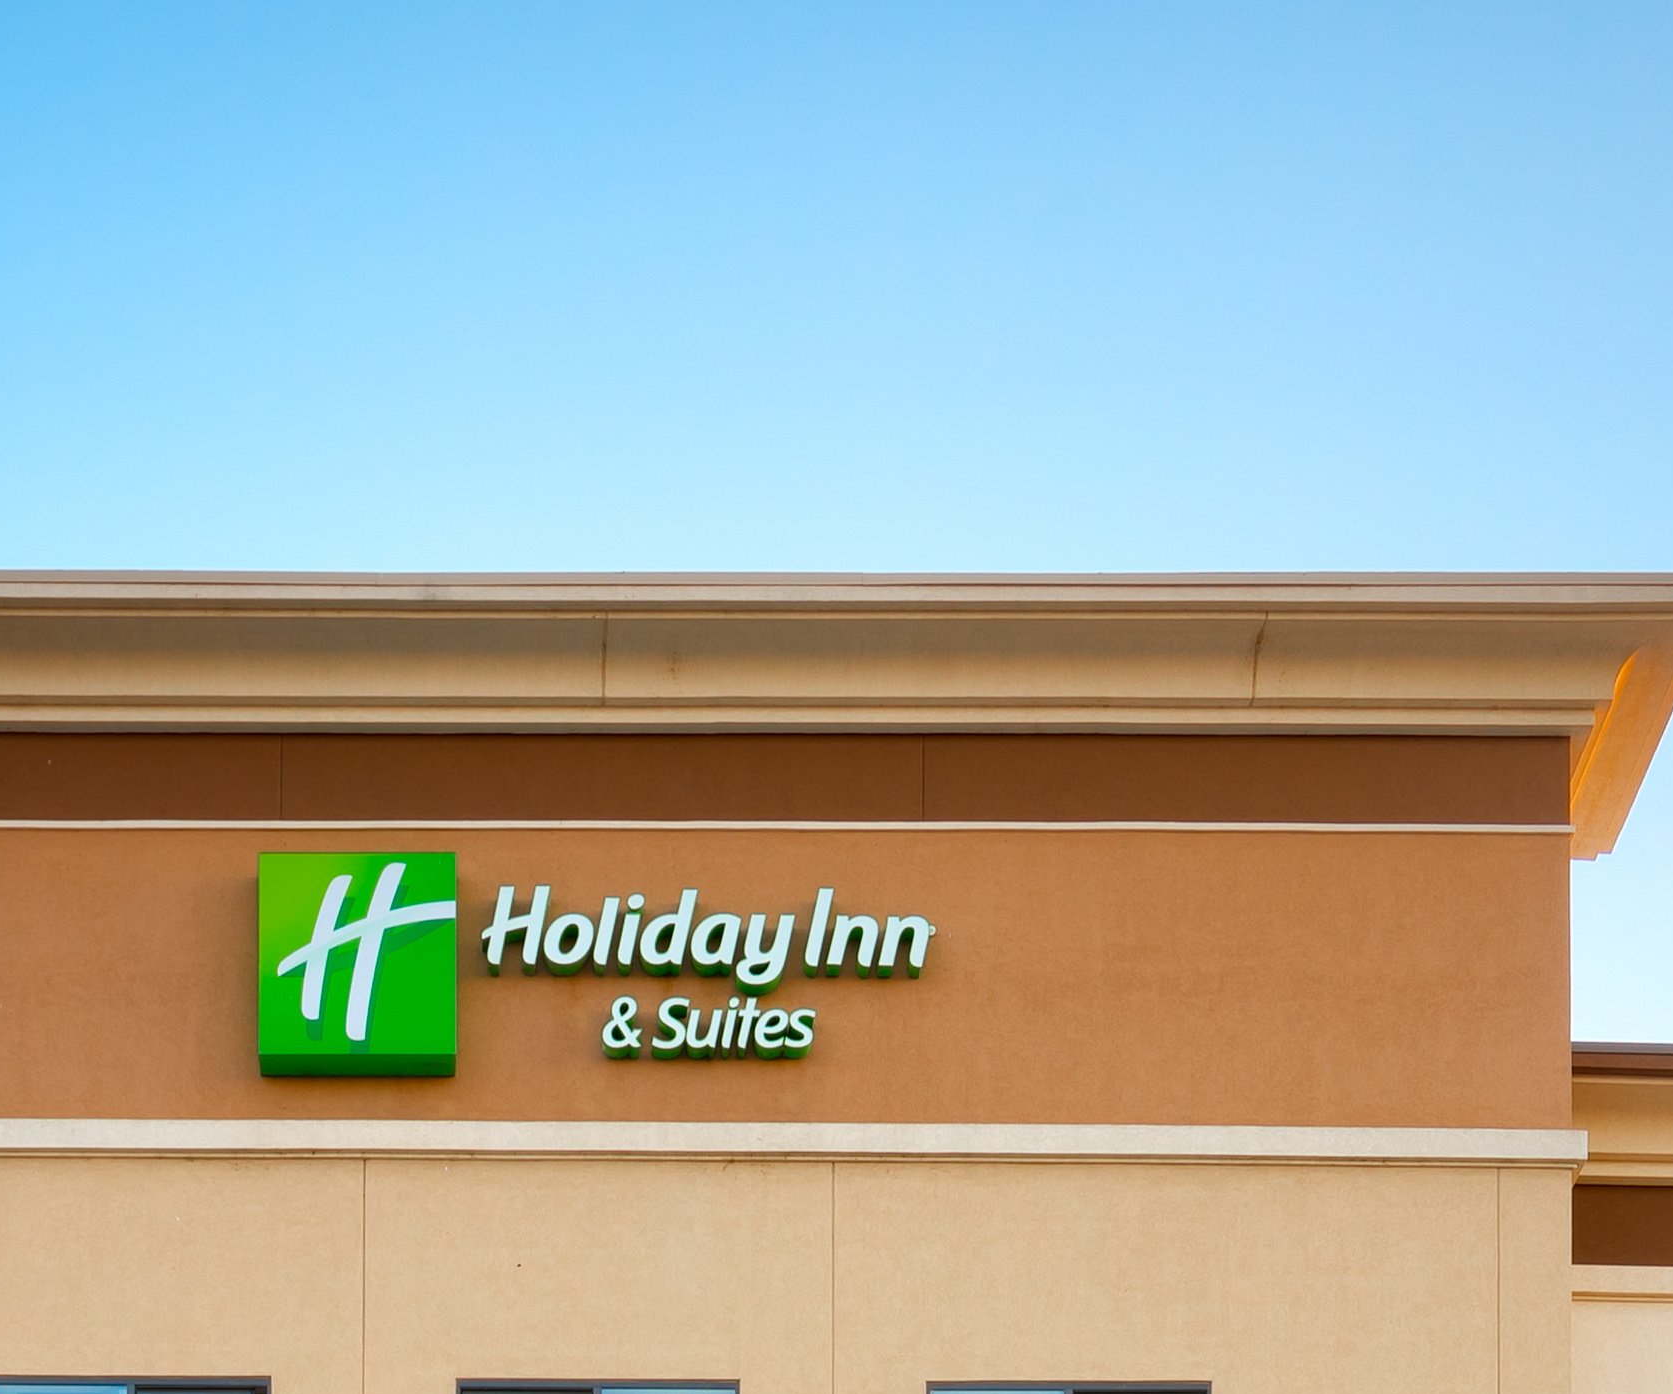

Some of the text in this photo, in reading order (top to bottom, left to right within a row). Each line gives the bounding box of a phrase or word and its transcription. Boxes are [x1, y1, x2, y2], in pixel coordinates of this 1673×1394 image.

[482, 884, 930, 989] Holiday Inn
[602, 996, 816, 1052] & Suites
